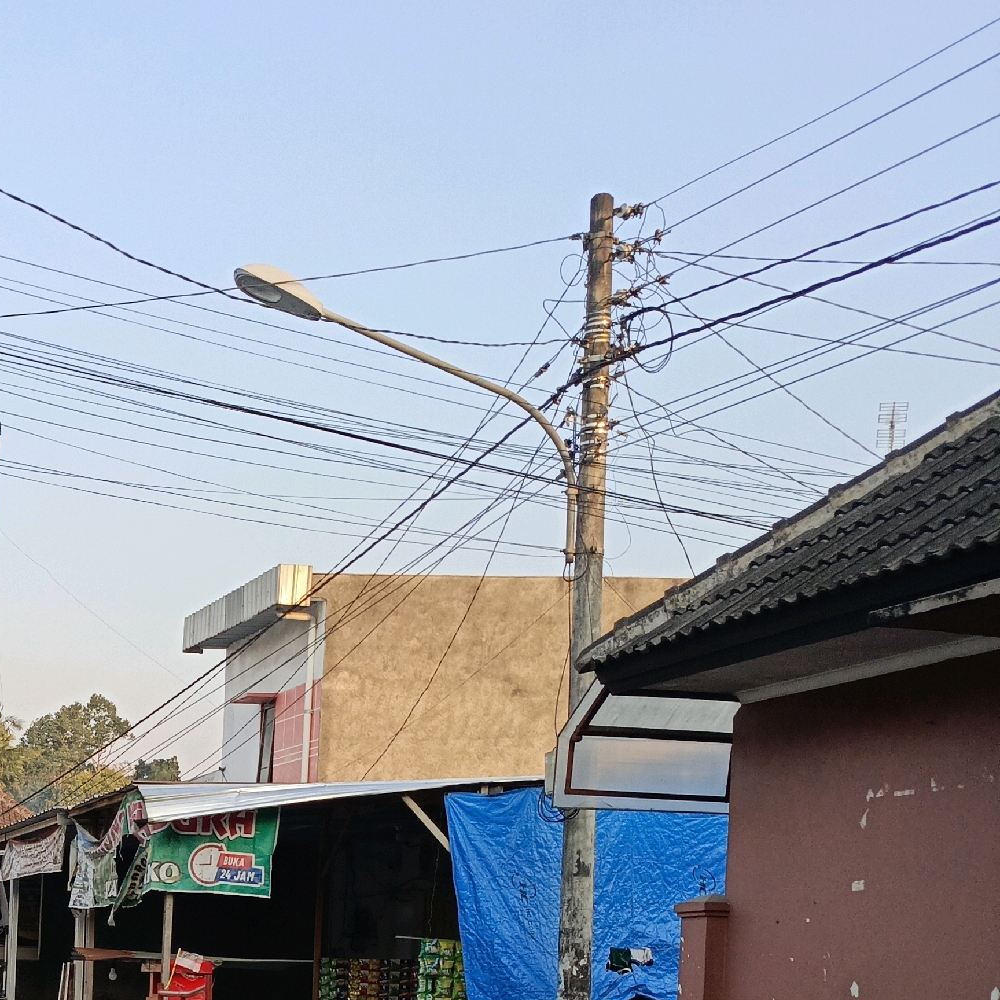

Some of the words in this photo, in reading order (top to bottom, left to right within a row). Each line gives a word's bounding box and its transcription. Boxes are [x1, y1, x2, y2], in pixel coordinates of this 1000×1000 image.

[222, 855, 245, 867] BUKA
[219, 868, 231, 879] 24
[233, 870, 256, 881] JAM
